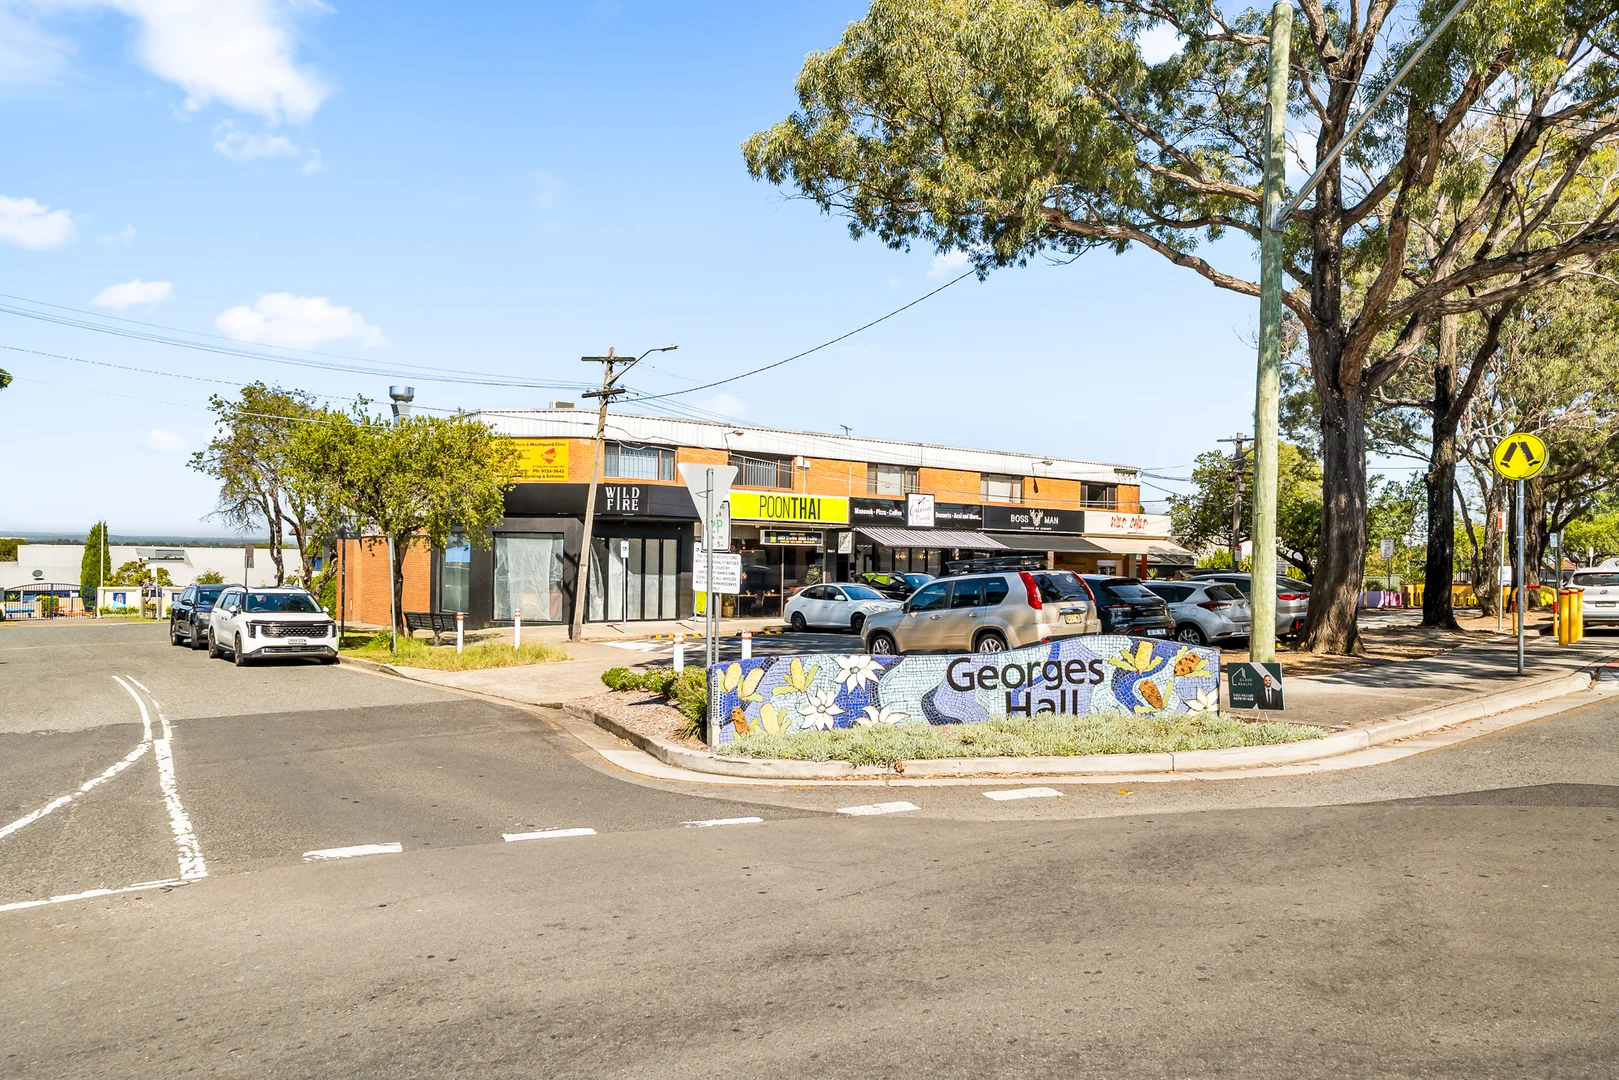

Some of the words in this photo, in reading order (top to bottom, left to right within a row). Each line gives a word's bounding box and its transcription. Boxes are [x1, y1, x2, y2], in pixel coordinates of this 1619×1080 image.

[605, 487, 640, 499] WILD
[606, 499, 639, 510] FIRE
[760, 495, 821, 520] POONTHAI
[1010, 514, 1028, 523] BOSS
[1044, 516, 1058, 524] MAN
[946, 657, 1104, 692] Georges
[1005, 689, 1078, 718] Hall
